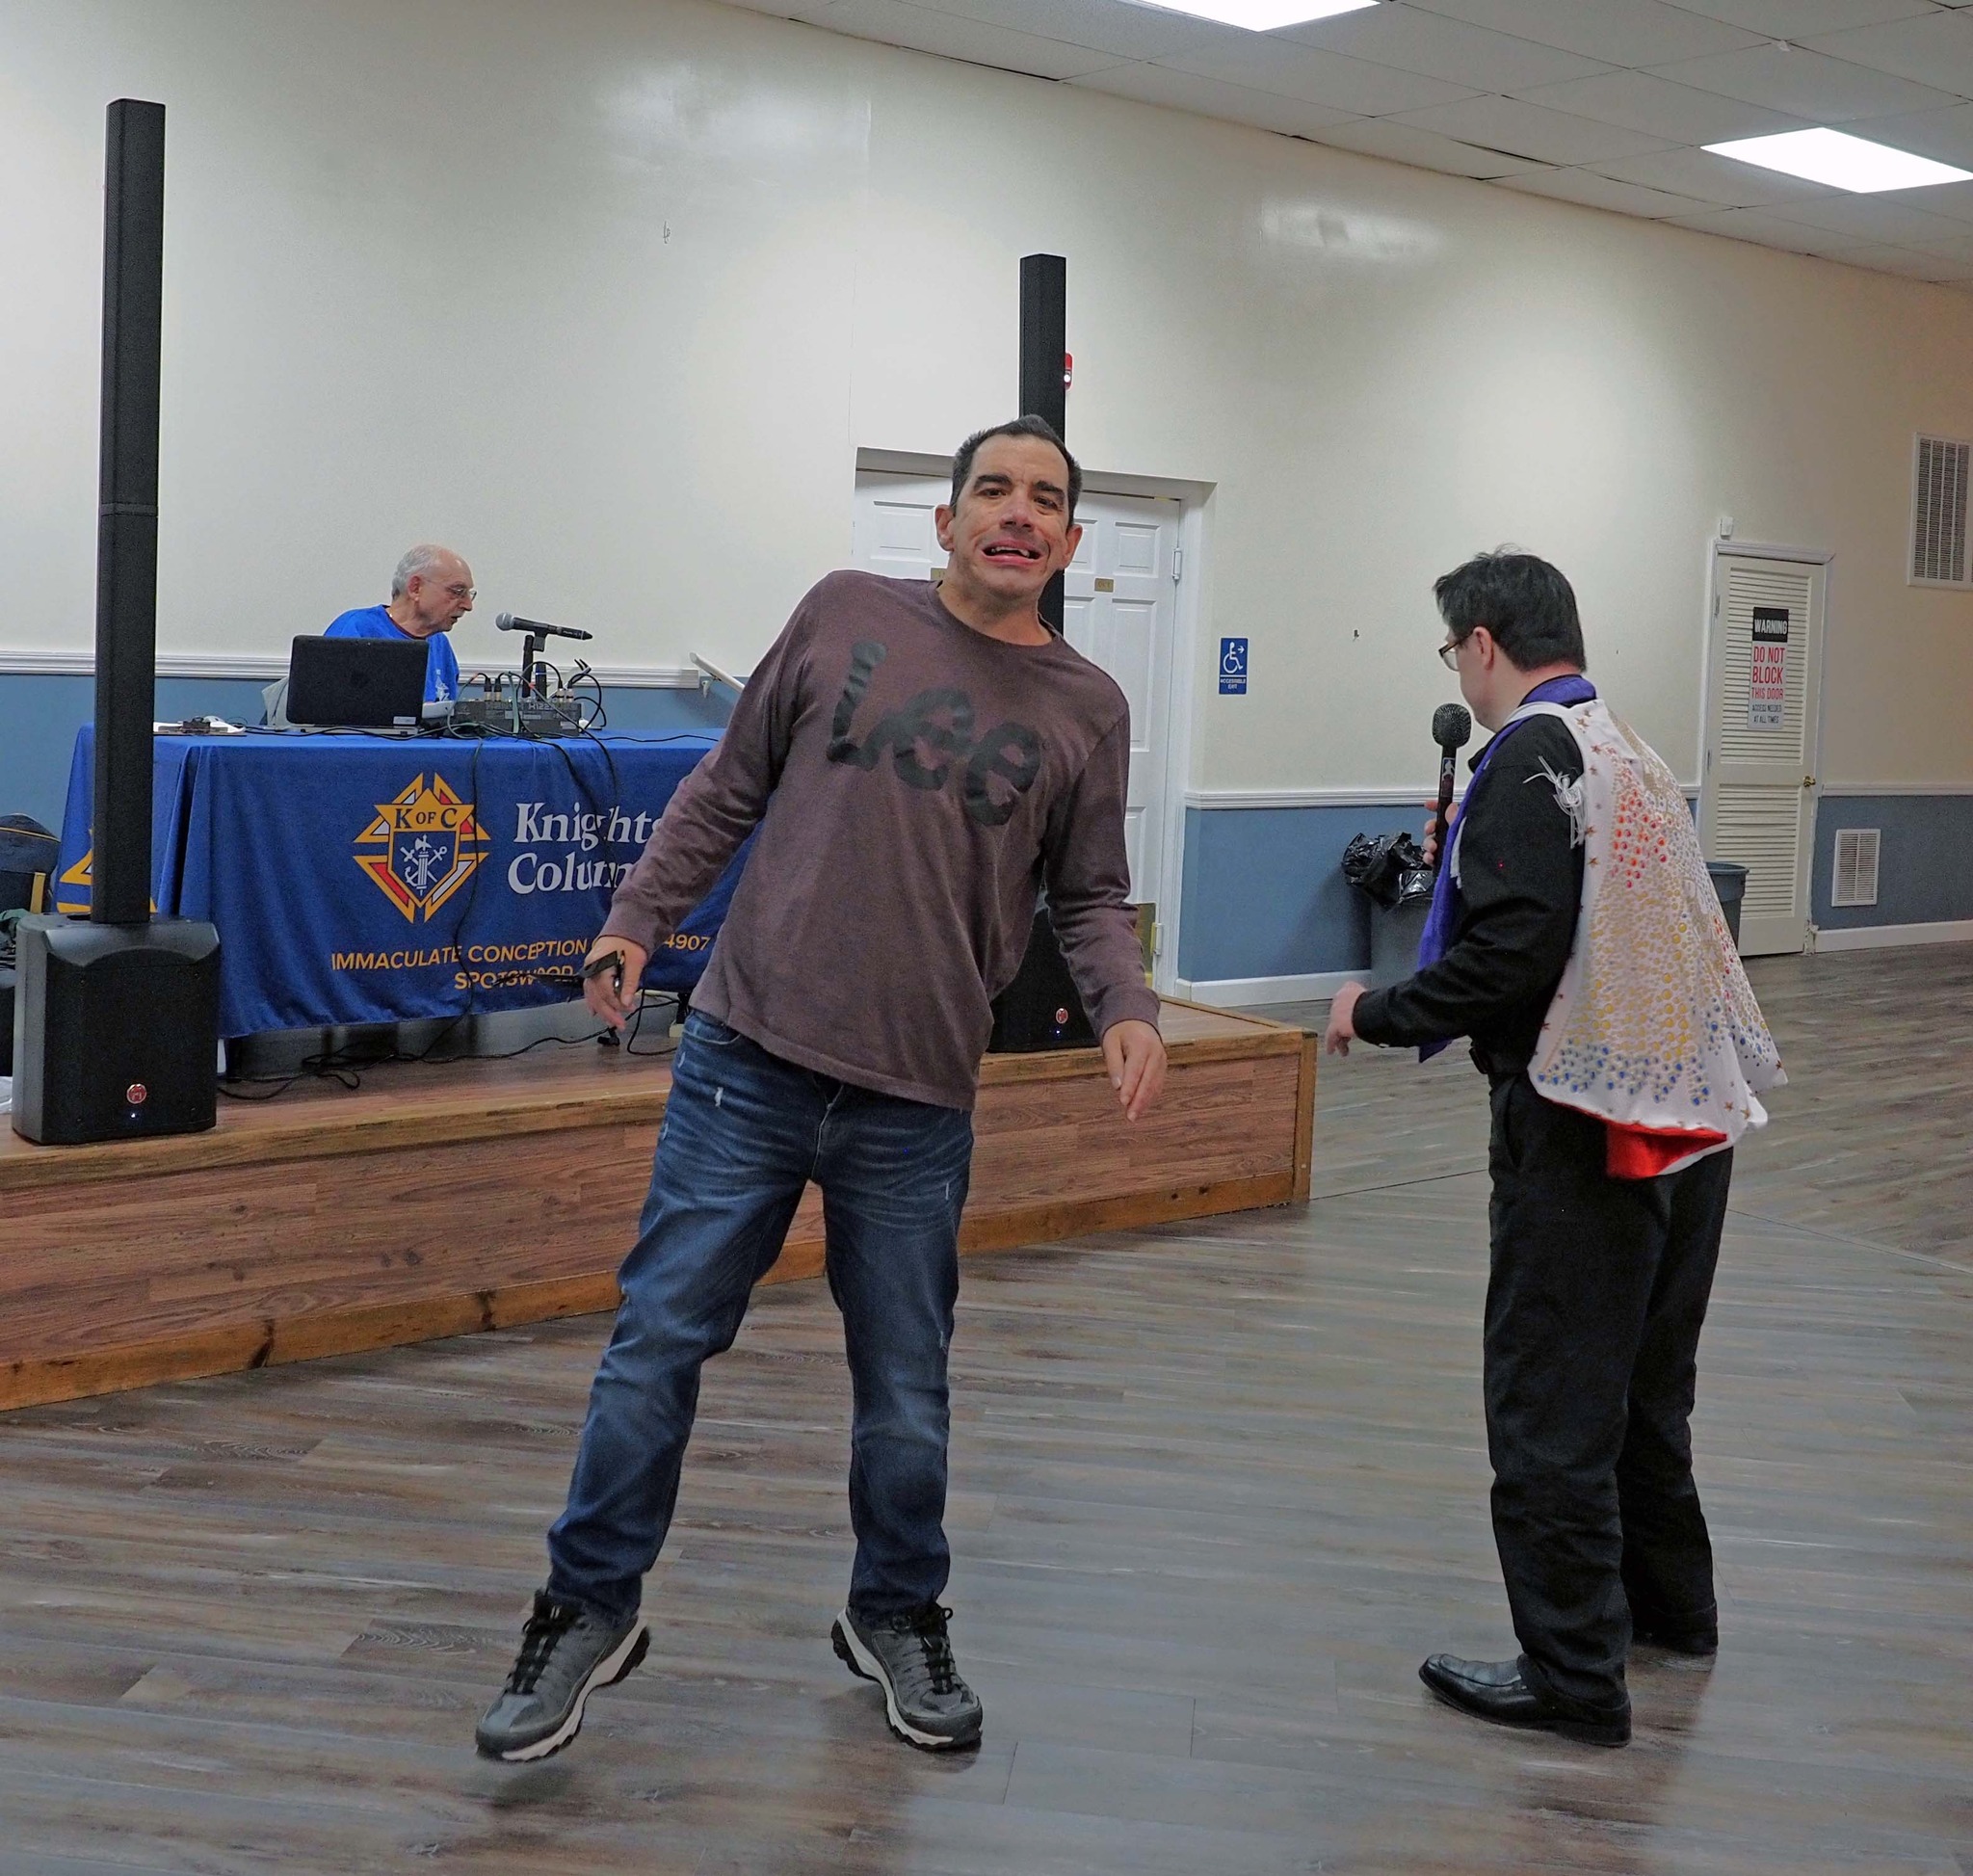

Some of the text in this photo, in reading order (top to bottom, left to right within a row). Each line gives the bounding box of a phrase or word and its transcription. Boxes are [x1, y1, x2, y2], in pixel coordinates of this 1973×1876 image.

[1754, 619, 1787, 635] WARNING
[1753, 646, 1785, 664] DO NOT
[1752, 666, 1783, 684] BLOCK
[1751, 687, 1783, 700] THIS DOOR
[395, 807, 458, 829] K OF C
[331, 945, 462, 970] IMMACULATE
[467, 938, 588, 963] CONCEPTION
[665, 933, 711, 951] 4907
